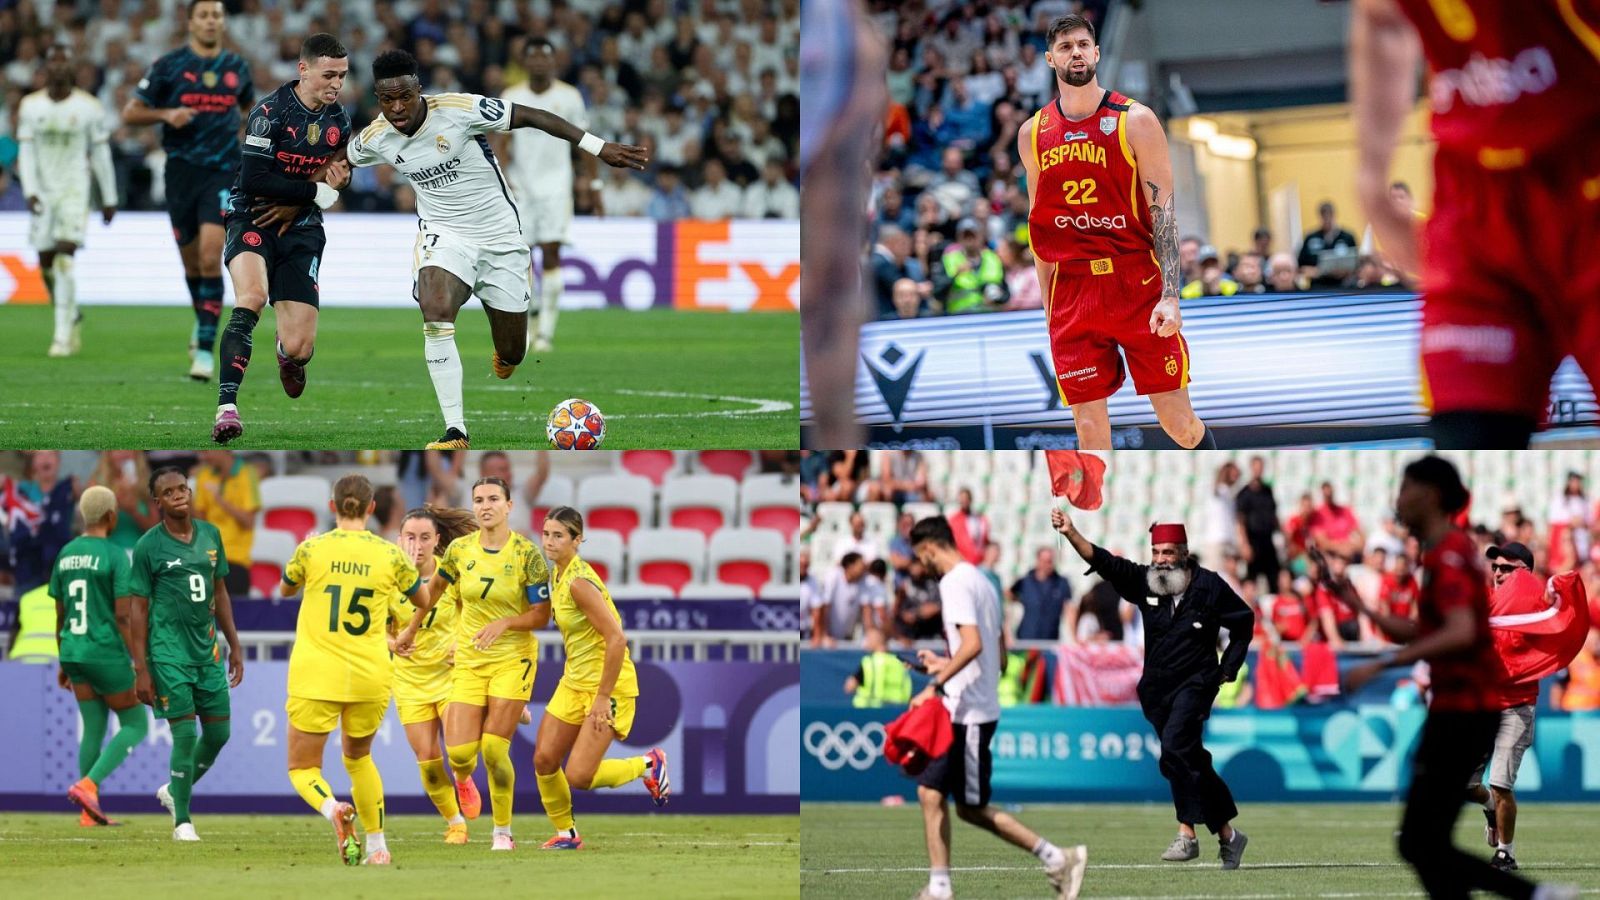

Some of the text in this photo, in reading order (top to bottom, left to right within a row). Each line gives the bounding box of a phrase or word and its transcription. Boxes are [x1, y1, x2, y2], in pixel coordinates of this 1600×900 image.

[479, 98, 505, 121] hp
[1041, 140, 1107, 171] ESPAÑA
[1062, 178, 1098, 205] 22
[1054, 211, 1127, 229] endesa
[331, 561, 371, 577] HUNT
[189, 574, 206, 603] 9
[480, 577, 495, 600] 7
[538, 586, 549, 599] C
[69, 579, 87, 635] 3
[324, 584, 375, 637] 15
[520, 658, 532, 681] 7
[990, 732, 1071, 760] ARIS
